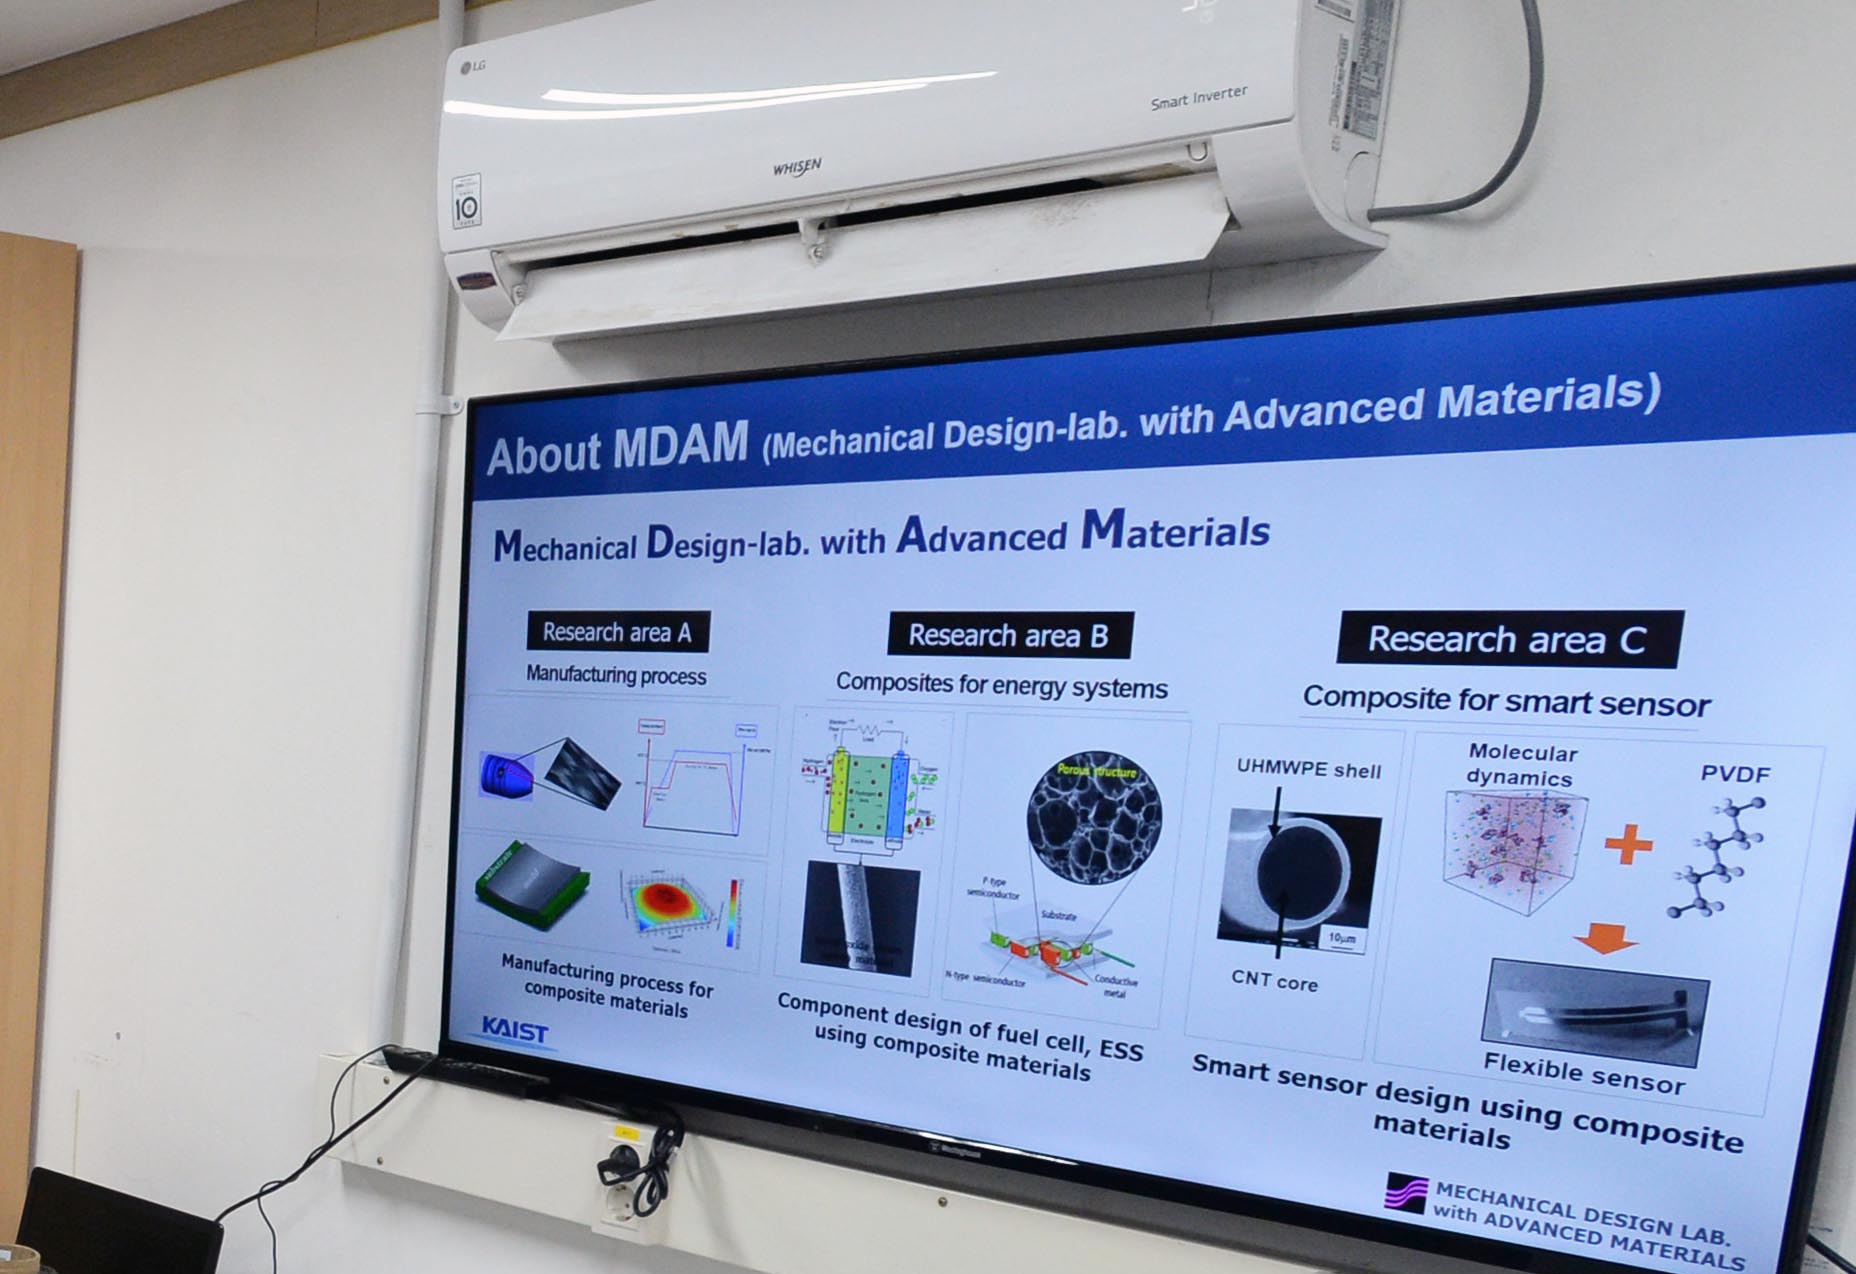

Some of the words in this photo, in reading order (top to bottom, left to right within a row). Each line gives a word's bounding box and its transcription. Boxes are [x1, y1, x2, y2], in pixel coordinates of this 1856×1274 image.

[473, 60, 486, 71] LG
[1151, 95, 1188, 111] Smart
[1193, 85, 1248, 104] Inverter
[773, 157, 822, 177] WHISEN
[456, 196, 478, 221] 10
[487, 433, 601, 476] About
[614, 419, 749, 468] MDAM
[763, 422, 934, 466] (Mechanical
[944, 410, 1128, 451] Design-lab.
[1140, 405, 1214, 437] with
[1224, 388, 1425, 432] Advanced
[1437, 372, 1661, 419] Materials)
[494, 529, 637, 562] Mechanical
[647, 524, 810, 563] Design-lab.
[821, 527, 885, 555] with
[896, 514, 1067, 553] Advanced
[1081, 507, 1270, 549] Materials
[544, 620, 625, 644] Research
[630, 626, 672, 644] area
[677, 622, 692, 644] A
[909, 622, 1019, 648] Research
[1025, 629, 1082, 648] area
[1091, 624, 1109, 648] B
[1369, 625, 1517, 654] Research
[1530, 629, 1606, 655] area
[1620, 626, 1646, 655] C
[527, 664, 637, 688] Manufacturing
[641, 669, 707, 690] process
[837, 671, 953, 697] Composites
[959, 673, 988, 694] for
[992, 678, 1066, 701] energy
[1071, 677, 1169, 702] systems
[1304, 683, 1451, 716] Composite
[1458, 687, 1497, 715] for
[1505, 691, 1592, 717] smart
[1600, 694, 1712, 719] sensor
[1469, 743, 1579, 764] Molecular
[1058, 763, 1090, 776] Porous
[1237, 757, 1327, 777] UHMWPE
[1334, 761, 1382, 780] shell
[1467, 768, 1573, 791] dynamics
[1701, 764, 1772, 784] PVDF
[967, 888, 1020, 900] semiconductor
[1041, 910, 1077, 922] Substrate
[502, 953, 615, 987] Manufacturing
[620, 972, 684, 995] process
[688, 979, 714, 999] for
[973, 973, 1026, 988] semiconductor
[1095, 974, 1138, 987] Conductive
[1232, 969, 1272, 987] CNT
[1277, 977, 1319, 992] core
[525, 980, 606, 1004] composite
[610, 993, 689, 1019] materials
[1104, 989, 1126, 999] metal
[482, 1015, 548, 1043] KAIST
[778, 992, 889, 1023] Component
[894, 1004, 962, 1036] design
[968, 1014, 991, 1038] of
[997, 1020, 1040, 1047] fuel
[1046, 1028, 1092, 1058] cell,
[1099, 1037, 1144, 1062] ESS
[815, 1022, 867, 1050] using
[873, 1031, 979, 1065] composite
[986, 1048, 1092, 1082] materials
[1484, 1052, 1583, 1083] Flexible
[1592, 1068, 1686, 1096] sensor
[1192, 1053, 1270, 1082] Smart
[1277, 1068, 1368, 1096] sensor
[1375, 1080, 1471, 1116] design
[1481, 1097, 1564, 1131] using
[1574, 1110, 1745, 1155] composite
[1373, 1115, 1512, 1151] materials
[1435, 1181, 1576, 1220] MECHANICAL
[1584, 1205, 1673, 1237] DESIGN
[1681, 1223, 1732, 1247] LAB.
[1432, 1202, 1478, 1225] with
[1484, 1210, 1604, 1245] ADVANCED
[1610, 1233, 1747, 1272] MATERIALS
